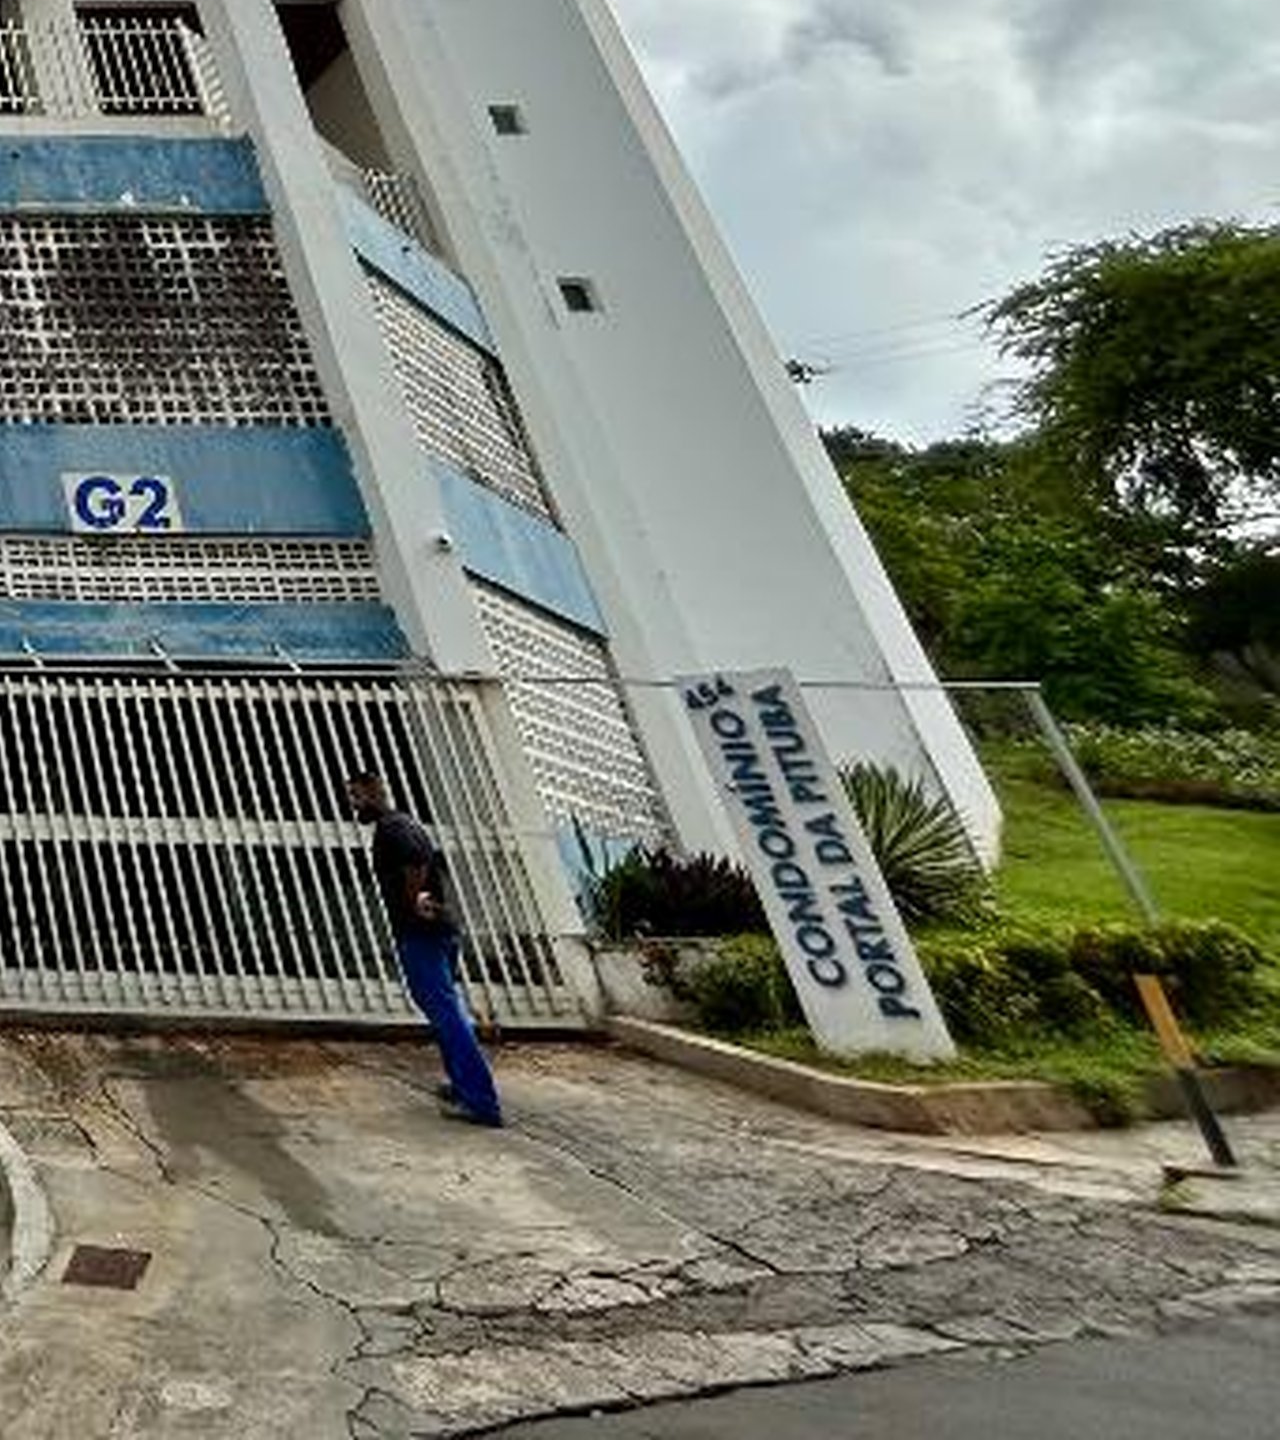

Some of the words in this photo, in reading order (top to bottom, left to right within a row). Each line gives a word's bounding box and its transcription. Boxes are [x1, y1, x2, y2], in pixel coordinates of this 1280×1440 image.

[75, 476, 171, 529] G2
[752, 684, 827, 805] PITUBA
[806, 813, 853, 866] DA
[829, 875, 922, 1020] PORTAL
